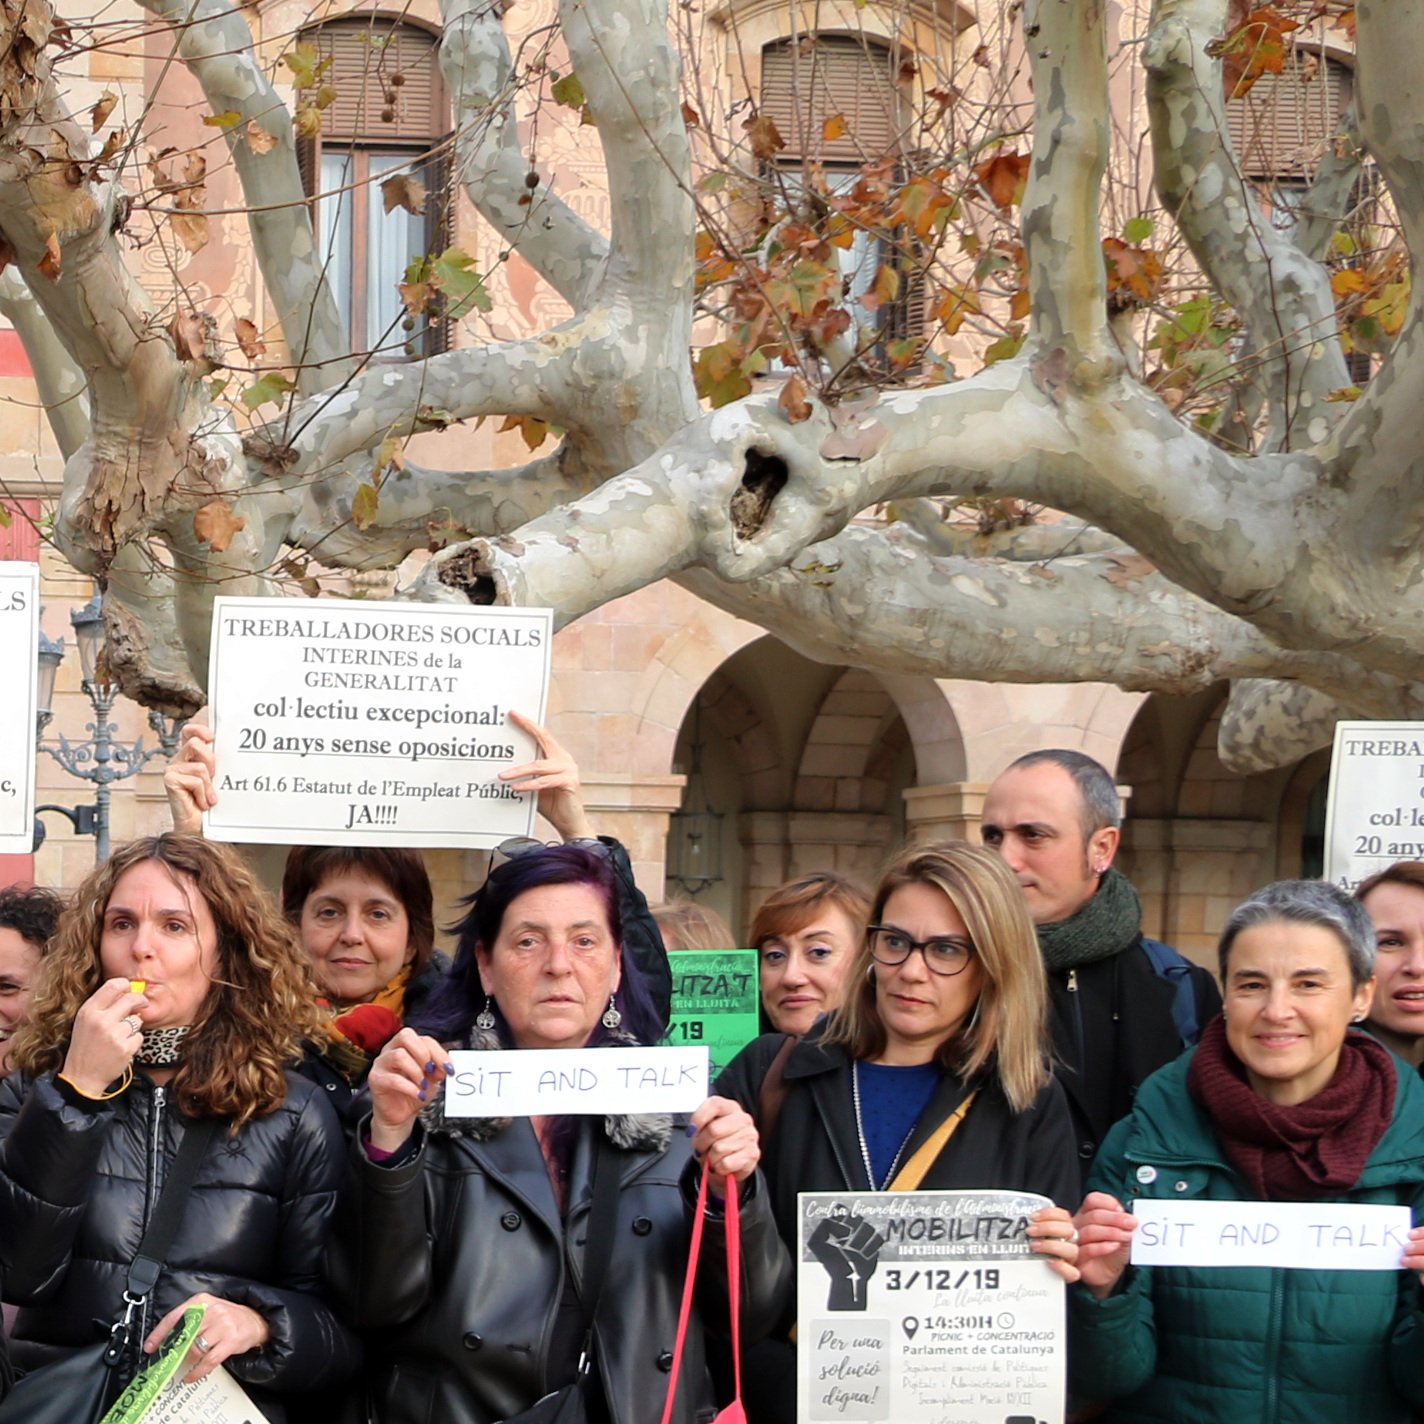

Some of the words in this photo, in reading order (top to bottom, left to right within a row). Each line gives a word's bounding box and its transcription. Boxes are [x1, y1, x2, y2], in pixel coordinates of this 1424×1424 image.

[225, 618, 434, 643] TREBALLADORES
[440, 626, 541, 647] SOCIALS
[303, 647, 418, 667] INTERINES
[423, 652, 443, 669] de
[448, 653, 461, 669] la
[305, 671, 458, 693] GENERALITAT
[366, 704, 505, 729] excepcional:
[239, 728, 266, 750] 20
[273, 734, 324, 757] anys
[331, 736, 391, 754] sense
[398, 735, 514, 761] oposicions
[220, 775, 248, 792] Art
[254, 776, 287, 793] 61.6
[293, 777, 353, 796] Estatut
[357, 780, 377, 796] de
[465, 783, 524, 803] Públic,
[345, 804, 398, 829] JA!!!!
[1354, 836, 1382, 854] 20
[697, 1000, 740, 1008] LLUITA
[455, 1067, 513, 1098] SIT
[538, 1069, 599, 1093] AND
[617, 1064, 698, 1088] TALK
[1141, 1217, 1196, 1248] SIT
[1219, 1223, 1280, 1246] AND
[1309, 1224, 1404, 1248] TALK
[886, 1269, 999, 1290] 3/12/19
[818, 1330, 847, 1350] Per
[852, 1338, 883, 1349] una
[903, 1345, 968, 1355] Parlament
[972, 1345, 986, 1355] de
[990, 1345, 1054, 1357] Catalunya
[819, 1356, 880, 1380] solució
[822, 1386, 879, 1412] digna!
